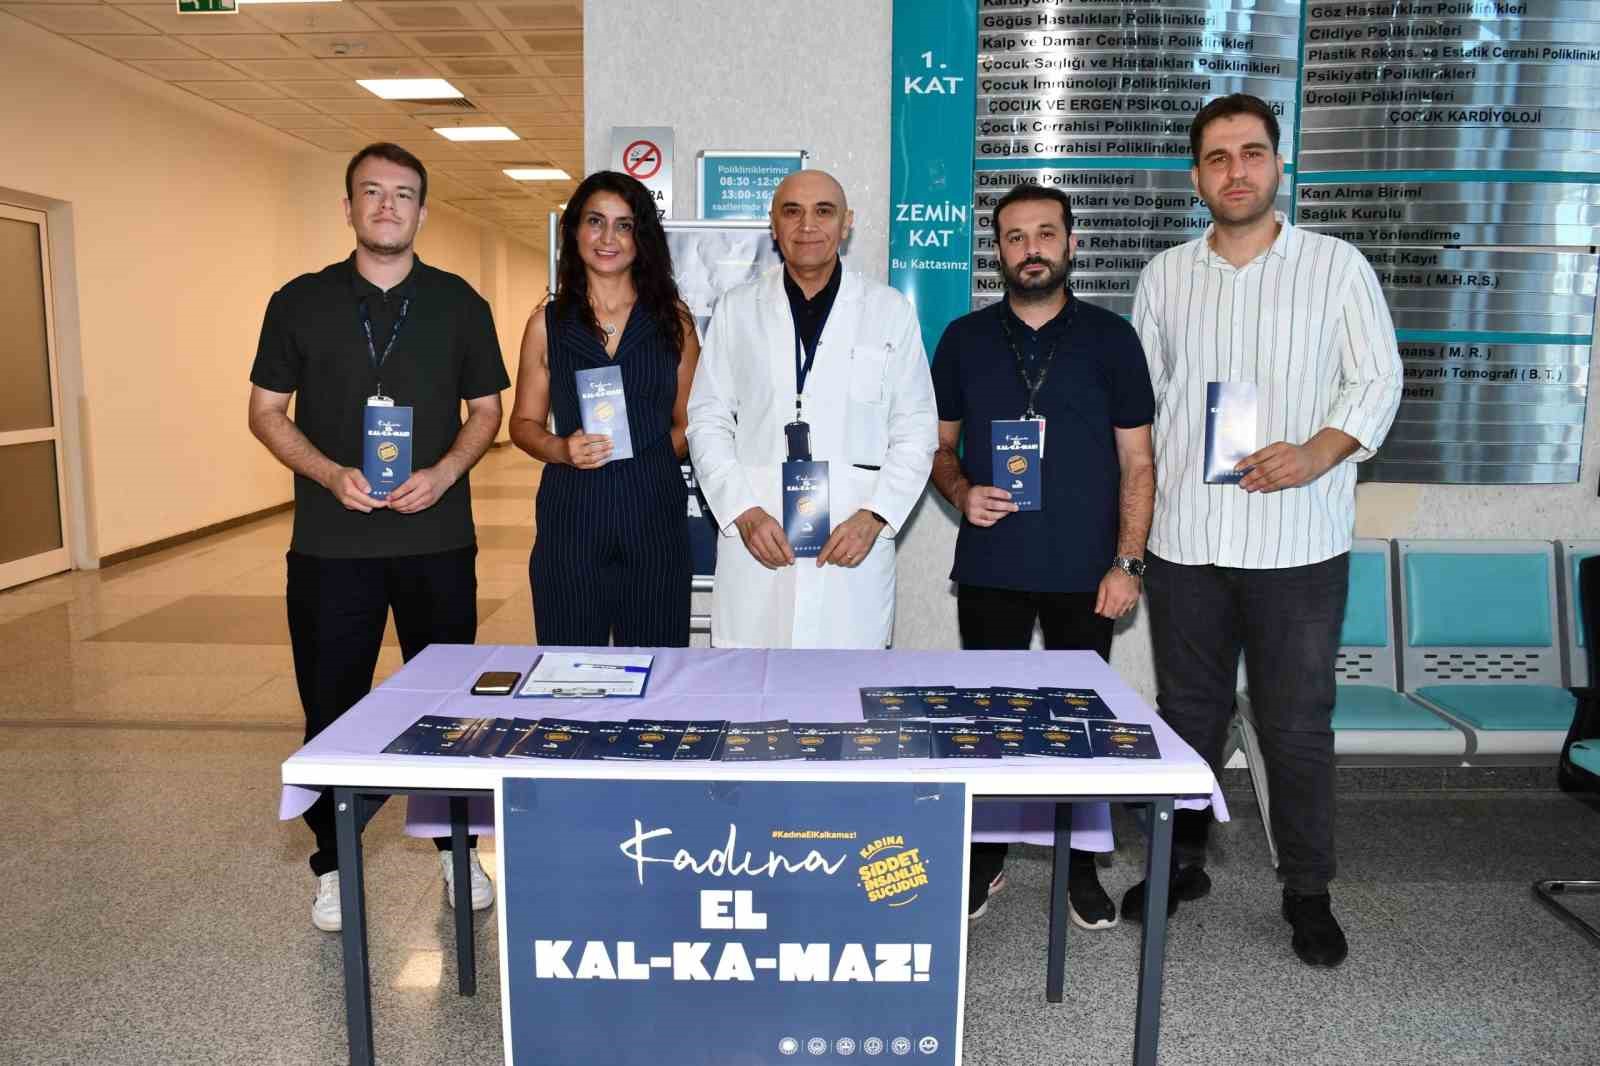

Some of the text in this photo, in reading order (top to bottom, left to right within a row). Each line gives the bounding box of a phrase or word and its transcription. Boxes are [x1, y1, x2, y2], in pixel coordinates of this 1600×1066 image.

[983, 12, 1216, 29] Göğüs Hastalıkları Poliklinikleri
[1311, 7, 1341, 18] Göz
[1309, 25, 1462, 41] Cildiye Poliklinikleri
[982, 37, 1016, 50] Kalp
[1043, 35, 1090, 46] Damar
[1096, 34, 1163, 47] Cerrahisi
[1168, 35, 1254, 49] Poliklinikleri
[920, 51, 947, 69] 1.
[1308, 48, 1357, 60] Plastik
[1443, 46, 1488, 58] Estetik
[1492, 47, 1538, 59] Cerrahi
[982, 59, 1029, 72] Çocuk
[1090, 59, 1108, 67] ve
[1112, 57, 1194, 69] Hastalıkları
[1199, 58, 1280, 74] Poliklinikleri
[1306, 68, 1477, 82] Psikiyatri Poliklinikleri
[904, 76, 964, 94] KAT
[982, 79, 1029, 93] Çocuk
[1121, 77, 1211, 90] Poliklinikleri
[1306, 90, 1455, 104] Üroloji Poliklinikleri
[989, 99, 1041, 113] ÇOCUK
[1046, 99, 1065, 110] VE
[1070, 98, 1122, 111] ERGEN
[1390, 107, 1542, 124] ÇOCUK KARDİYOLOJİ
[981, 121, 1028, 136] Çocuk
[1105, 120, 1193, 133] Poliklinikler
[980, 142, 1029, 156] Göğüs
[1106, 142, 1192, 153] Poliklinikler
[979, 173, 1134, 186] Dahiliye Poliklinikleri
[1112, 197, 1130, 206] ve
[1134, 194, 1186, 208] Doğum
[1301, 187, 1423, 199] Kan Alma Birimi
[895, 200, 967, 222] ZEMİN
[1301, 208, 1403, 222] Sağlık Kurulu
[909, 229, 954, 247] KAT
[892, 258, 969, 271] Bu Kattasınız
[1400, 252, 1438, 265] Kayıt
[1381, 274, 1422, 285] Hasta
[1451, 367, 1518, 381] Tomografi
[619, 818, 847, 886] Kadına
[859, 835, 904, 858] KADINA
[868, 874, 929, 902] SUÇUDUR
[700, 890, 768, 930] EL
[534, 940, 933, 982] KAL-KA-MAZ!
